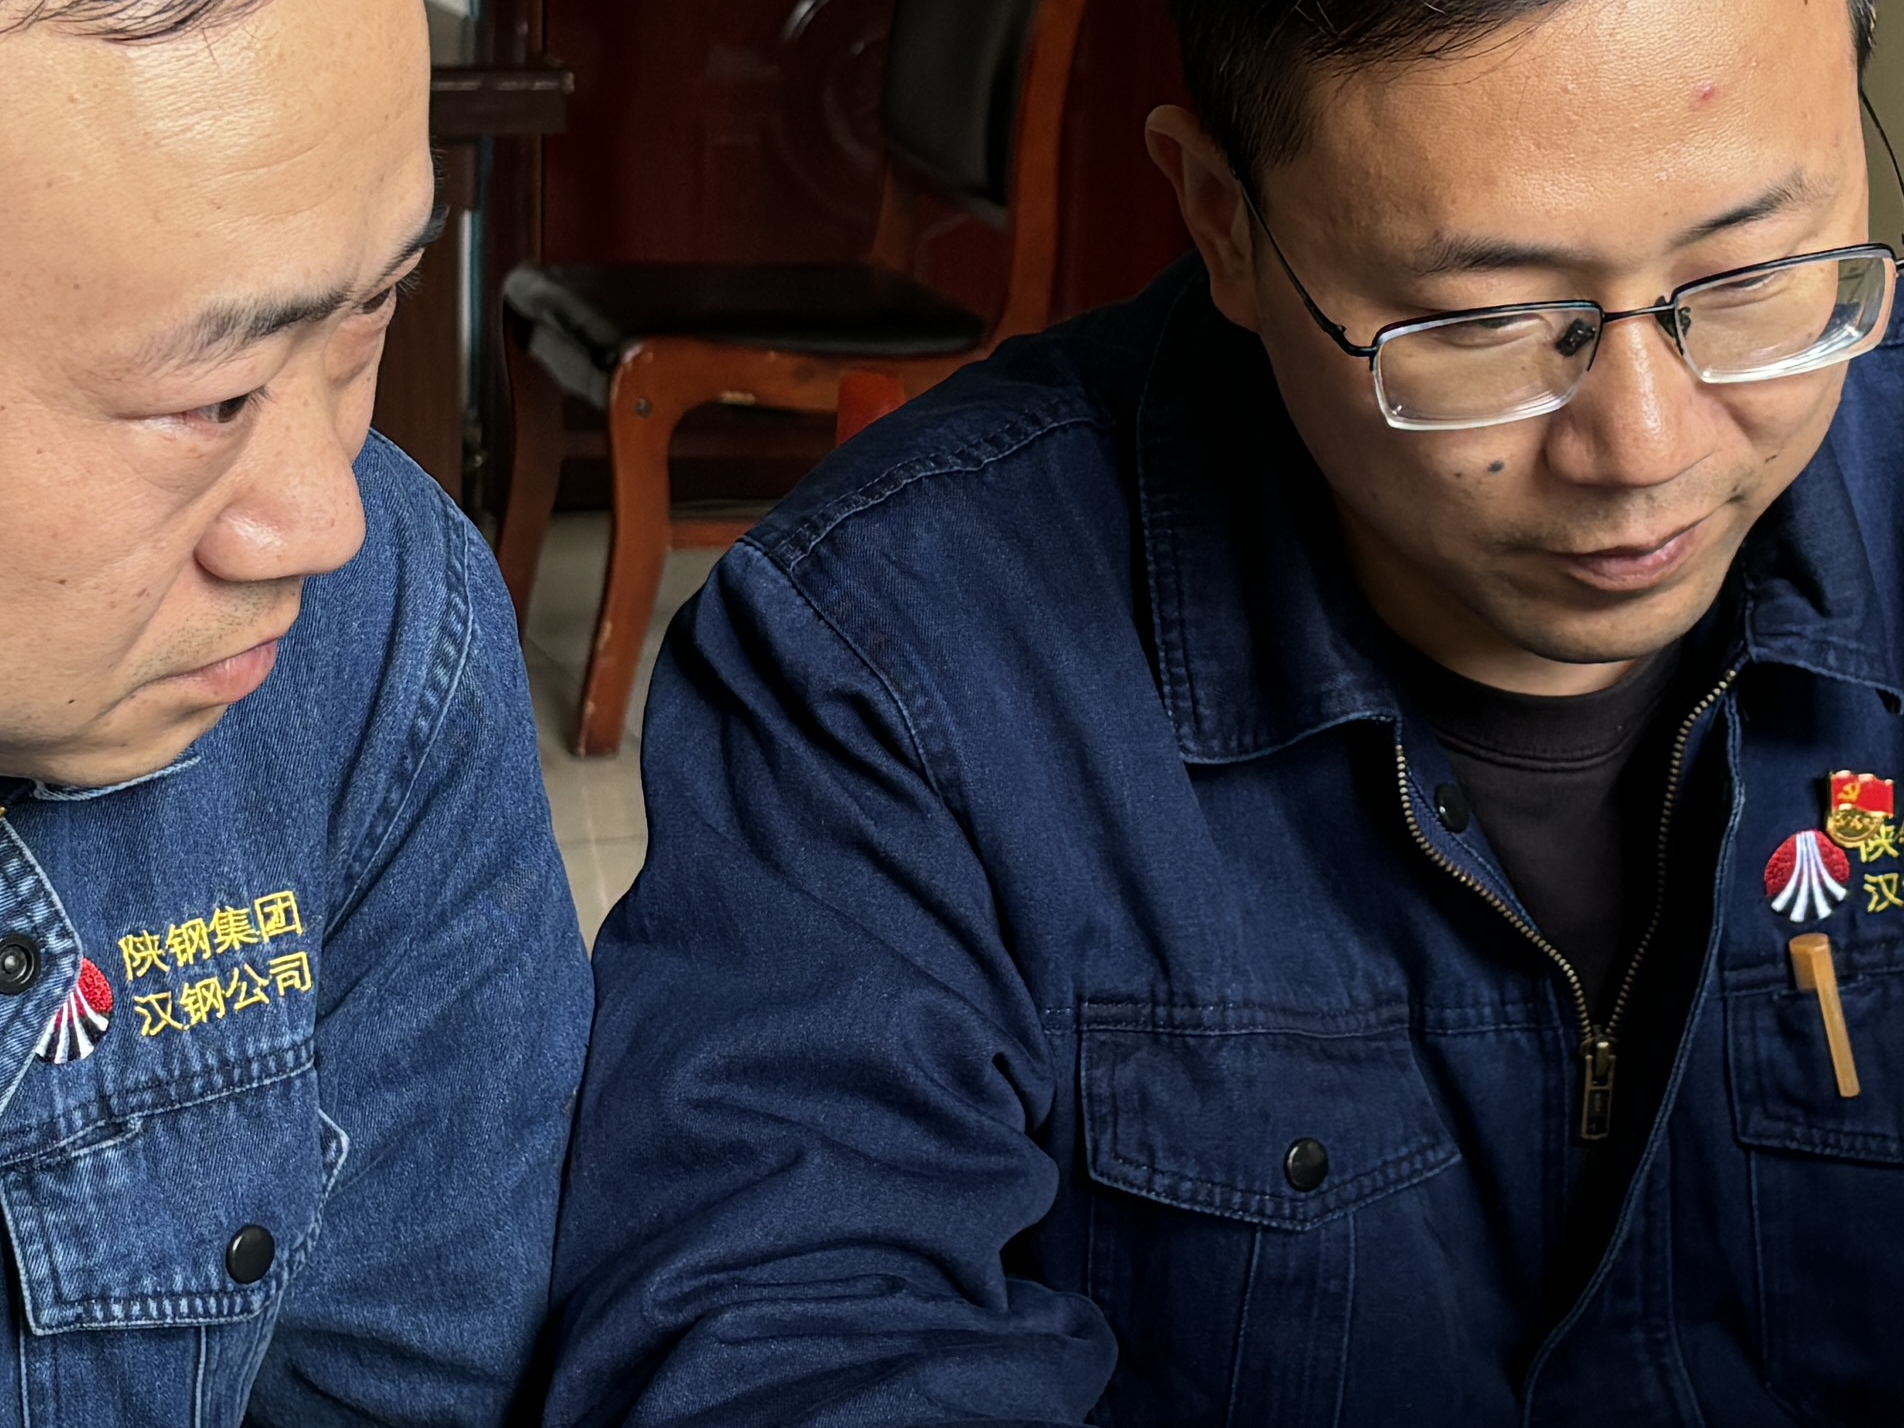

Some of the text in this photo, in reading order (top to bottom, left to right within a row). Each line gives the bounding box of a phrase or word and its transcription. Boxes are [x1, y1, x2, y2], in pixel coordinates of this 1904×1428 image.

[118, 889, 305, 983] 陕钢集团
[134, 950, 313, 1038] 汉钢公司
